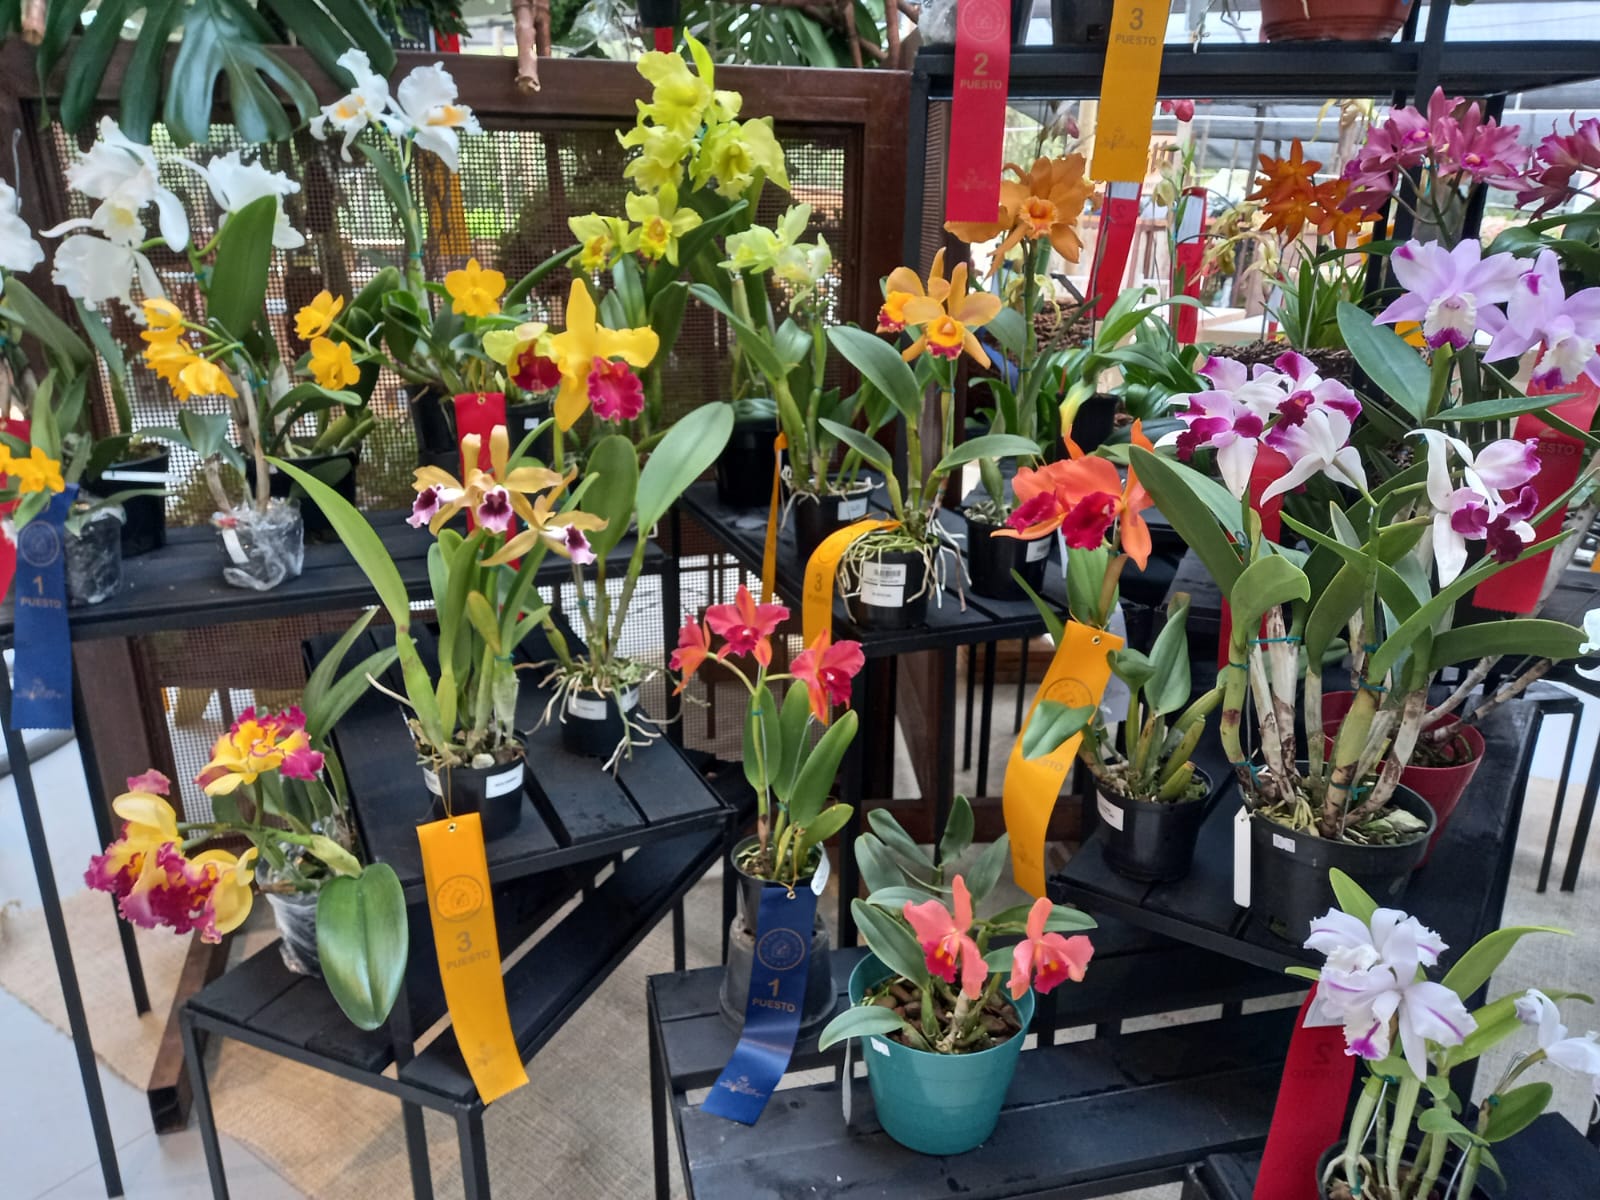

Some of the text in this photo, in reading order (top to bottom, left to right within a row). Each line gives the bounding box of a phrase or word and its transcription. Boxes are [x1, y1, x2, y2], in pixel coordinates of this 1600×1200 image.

[1128, 7, 1145, 31] 3
[1114, 33, 1158, 47] PUESTO
[972, 53, 989, 76] 2
[959, 79, 1003, 90] PUESTO
[32, 575, 45, 595] 1
[813, 572, 824, 593] 3
[20, 595, 62, 609] PUESTO
[456, 930, 473, 953] 3
[445, 949, 492, 971] PUESTO
[767, 977, 781, 997] 1
[751, 997, 797, 1013] PUESTO
